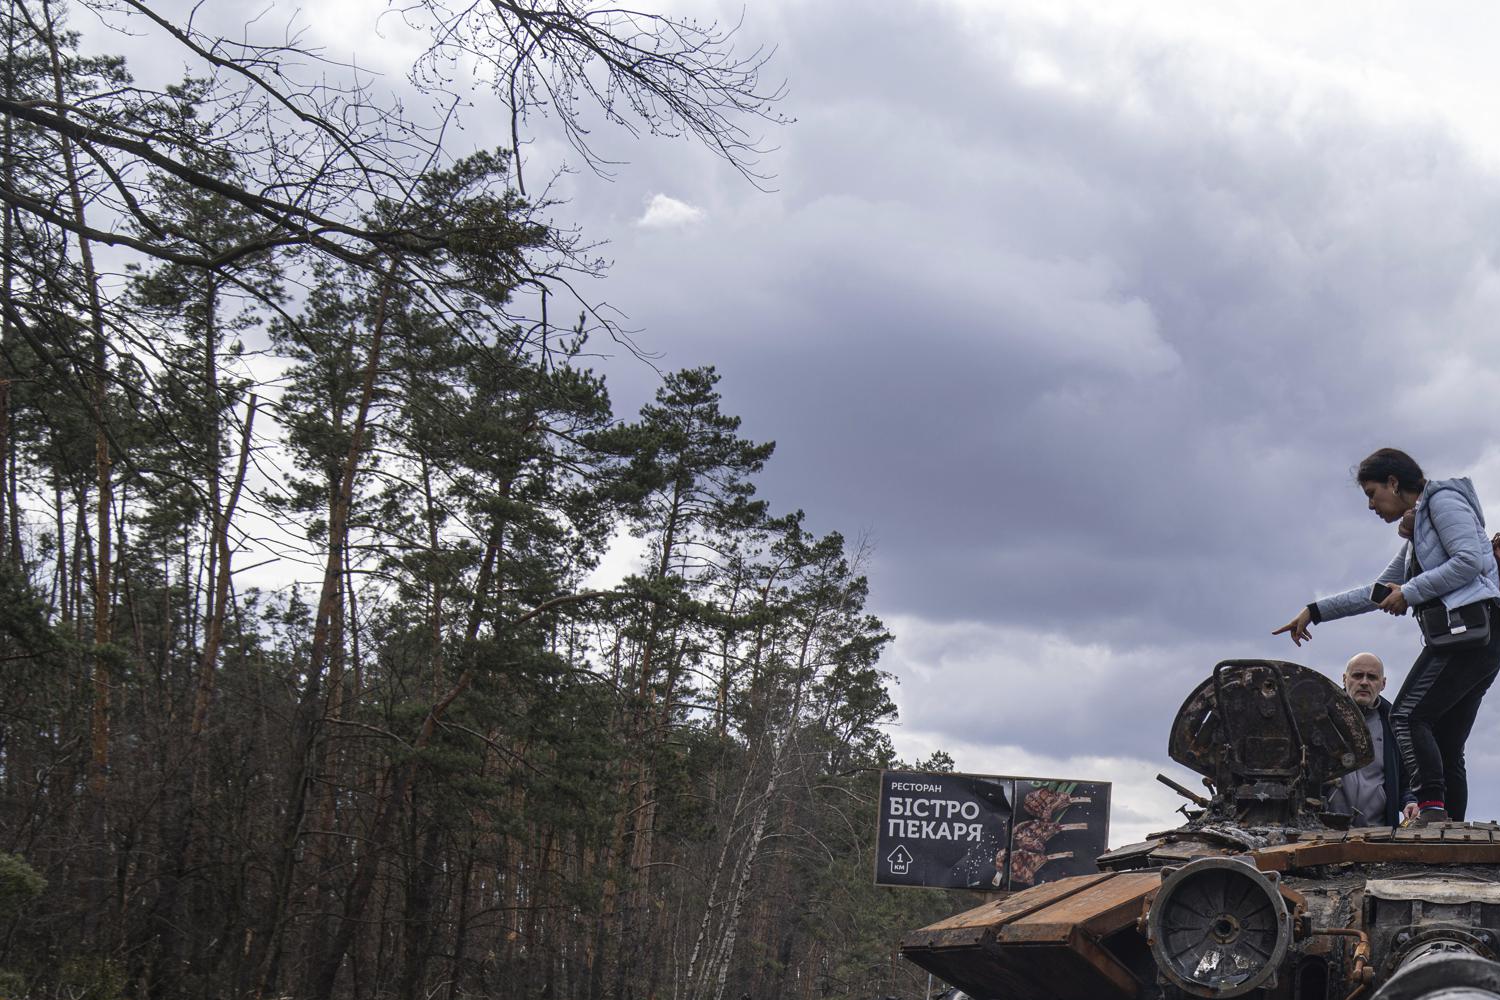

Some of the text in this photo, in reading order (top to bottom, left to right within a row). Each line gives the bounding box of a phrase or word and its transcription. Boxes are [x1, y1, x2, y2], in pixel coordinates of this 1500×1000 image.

[891, 782, 942, 793] РЕСТОРАН
[889, 797, 980, 820] БІСТРО
[888, 818, 983, 842] ПЕКАРЯ
[897, 853, 903, 863] 1
